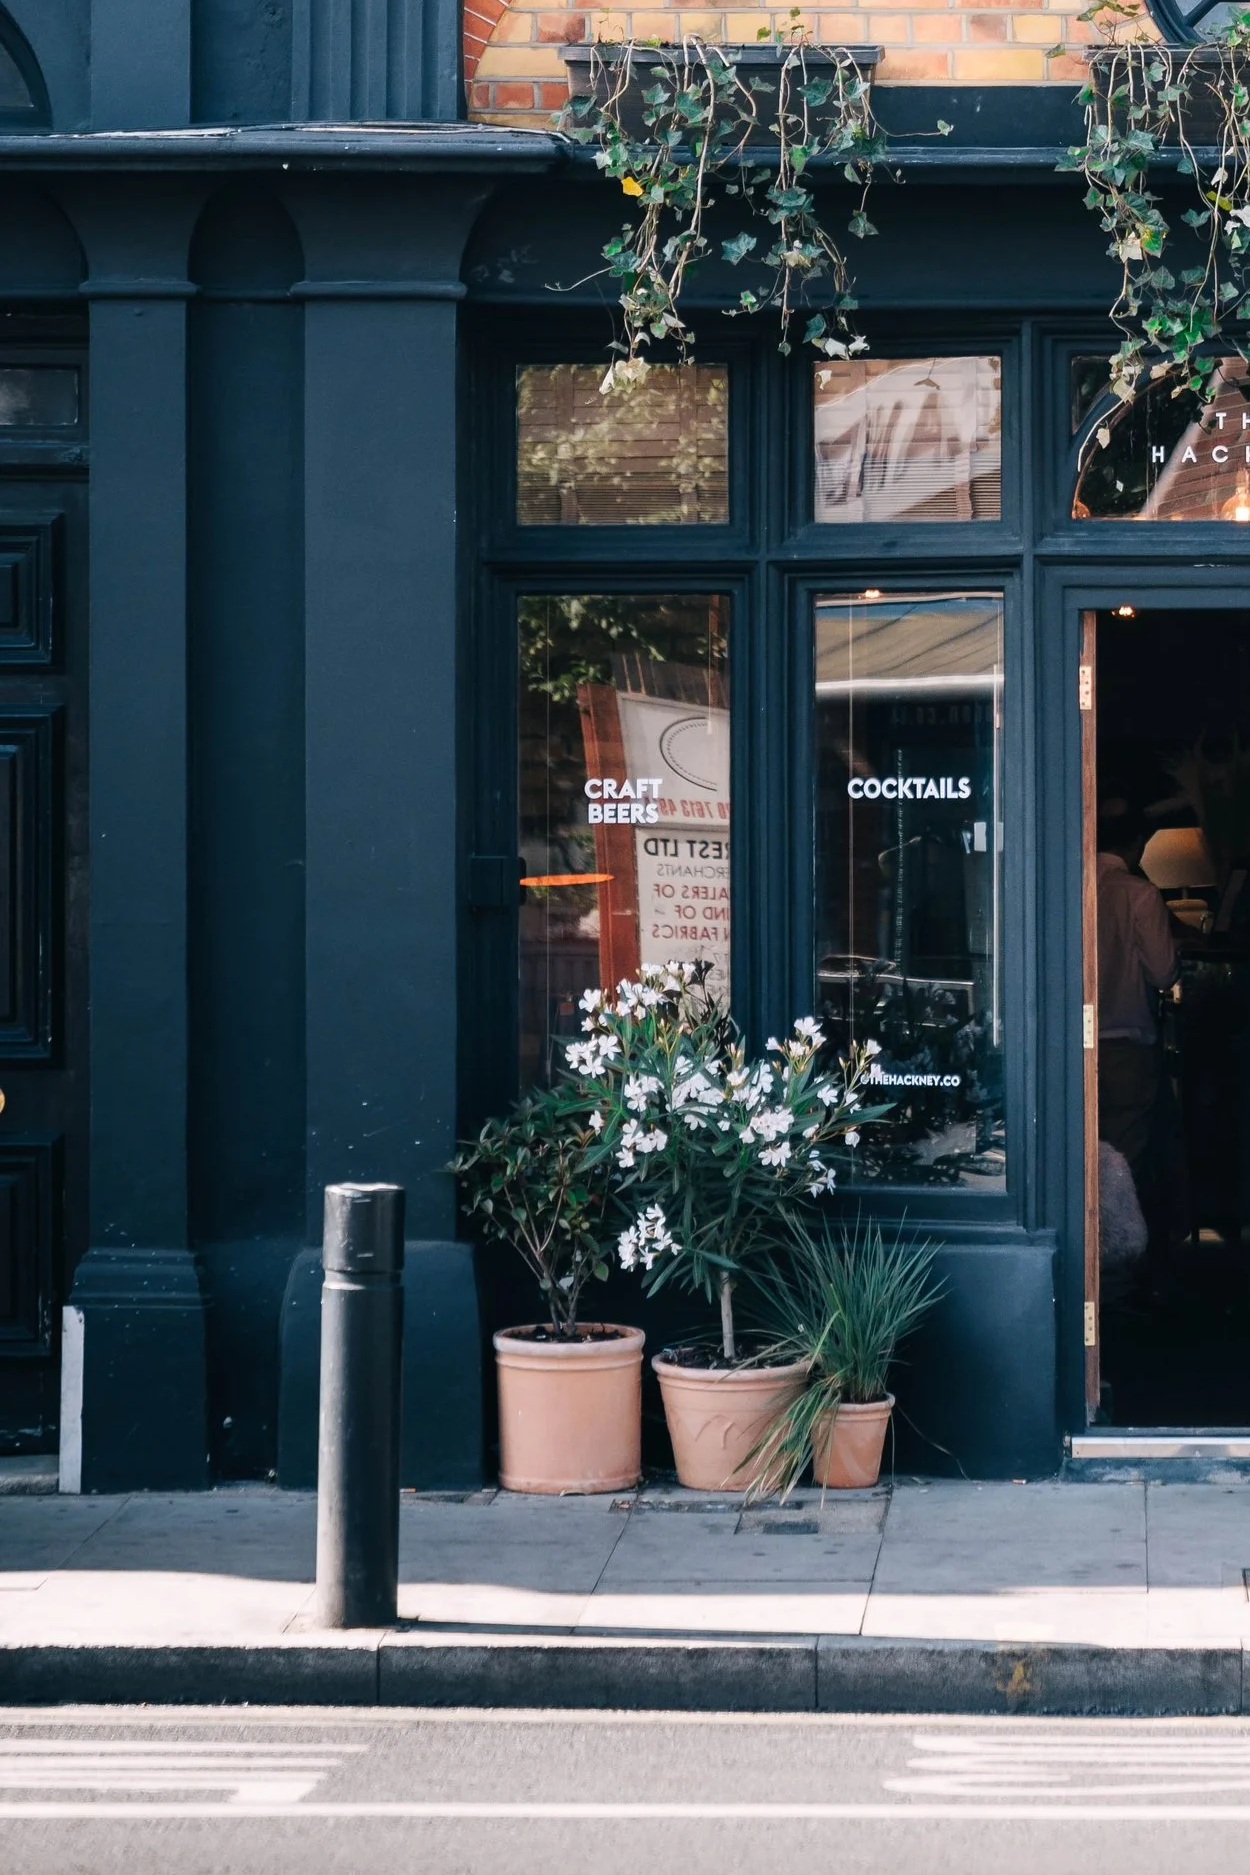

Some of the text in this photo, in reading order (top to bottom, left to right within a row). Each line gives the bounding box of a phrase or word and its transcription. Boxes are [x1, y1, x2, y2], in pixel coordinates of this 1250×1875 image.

[584, 778, 663, 799] CRAFT
[847, 778, 972, 800] COCKTAILS
[588, 802, 660, 824] BEERS
